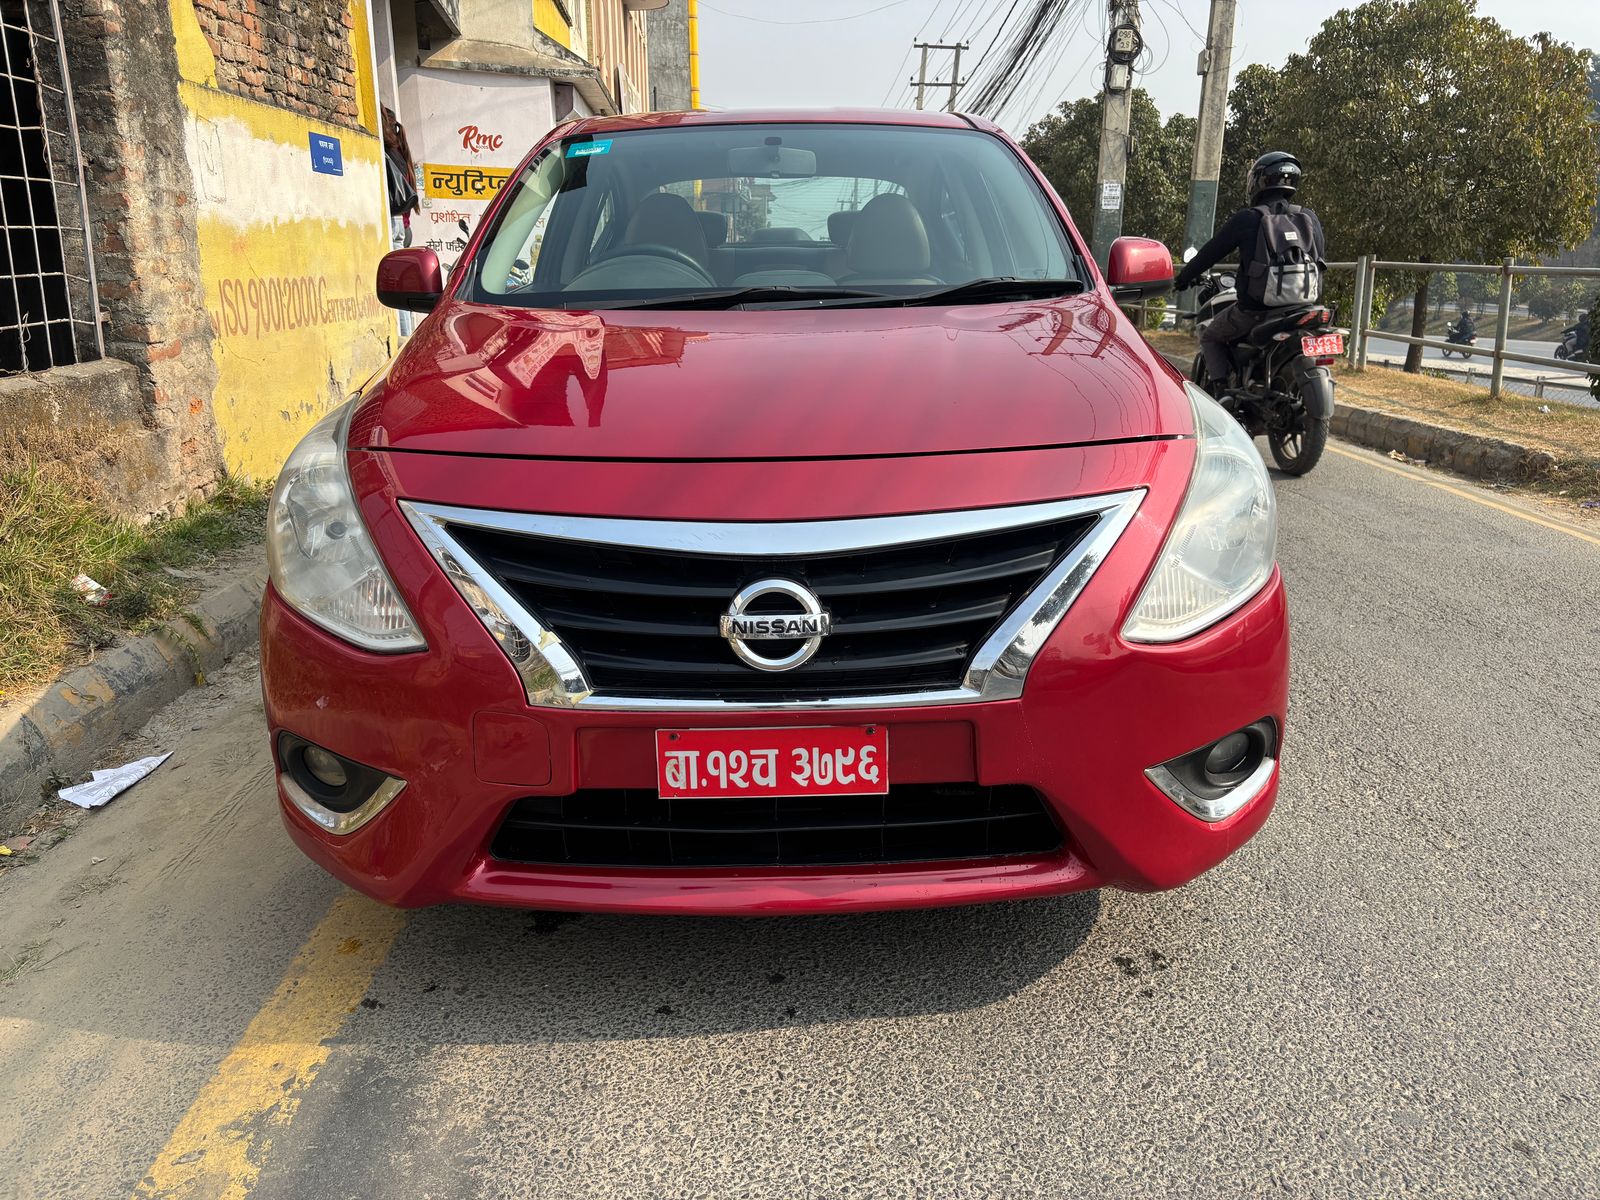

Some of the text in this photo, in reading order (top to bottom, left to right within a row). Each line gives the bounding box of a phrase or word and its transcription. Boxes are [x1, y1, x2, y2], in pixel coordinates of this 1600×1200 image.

[458, 125, 503, 153] Rmc
[218, 278, 248, 337] ISO
[732, 618, 818, 634] NISSAN
[664, 745, 880, 790] बा.१२च ३७५६
